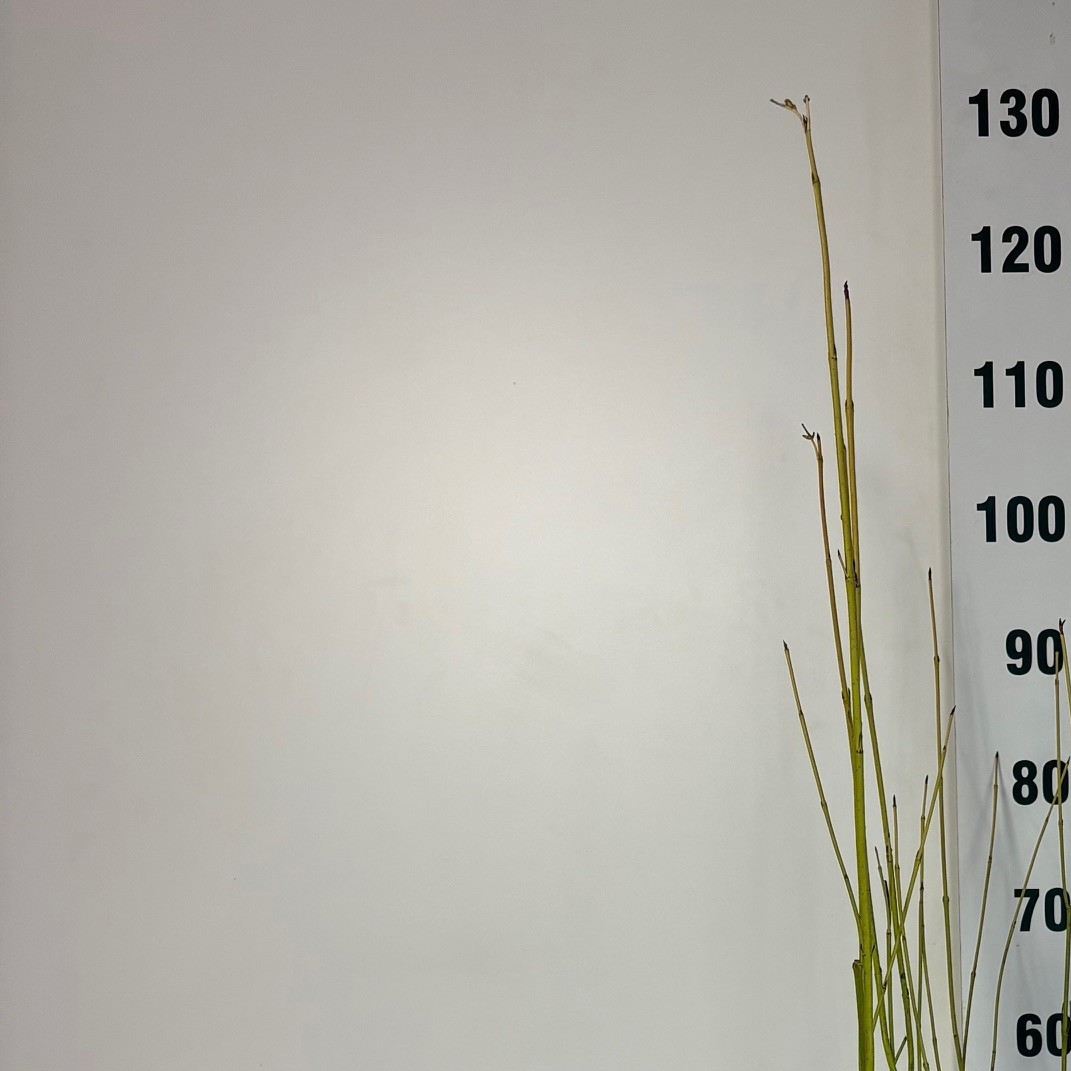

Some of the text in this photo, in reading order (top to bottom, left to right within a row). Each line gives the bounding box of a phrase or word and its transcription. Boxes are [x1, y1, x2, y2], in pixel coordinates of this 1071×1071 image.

[968, 88, 1060, 137] 130
[971, 225, 1062, 274] 120
[974, 360, 1064, 408] 110
[976, 495, 1066, 543] 100
[1005, 629, 1064, 676] 90
[1012, 759, 1070, 806] 80
[1013, 887, 1071, 932] 70
